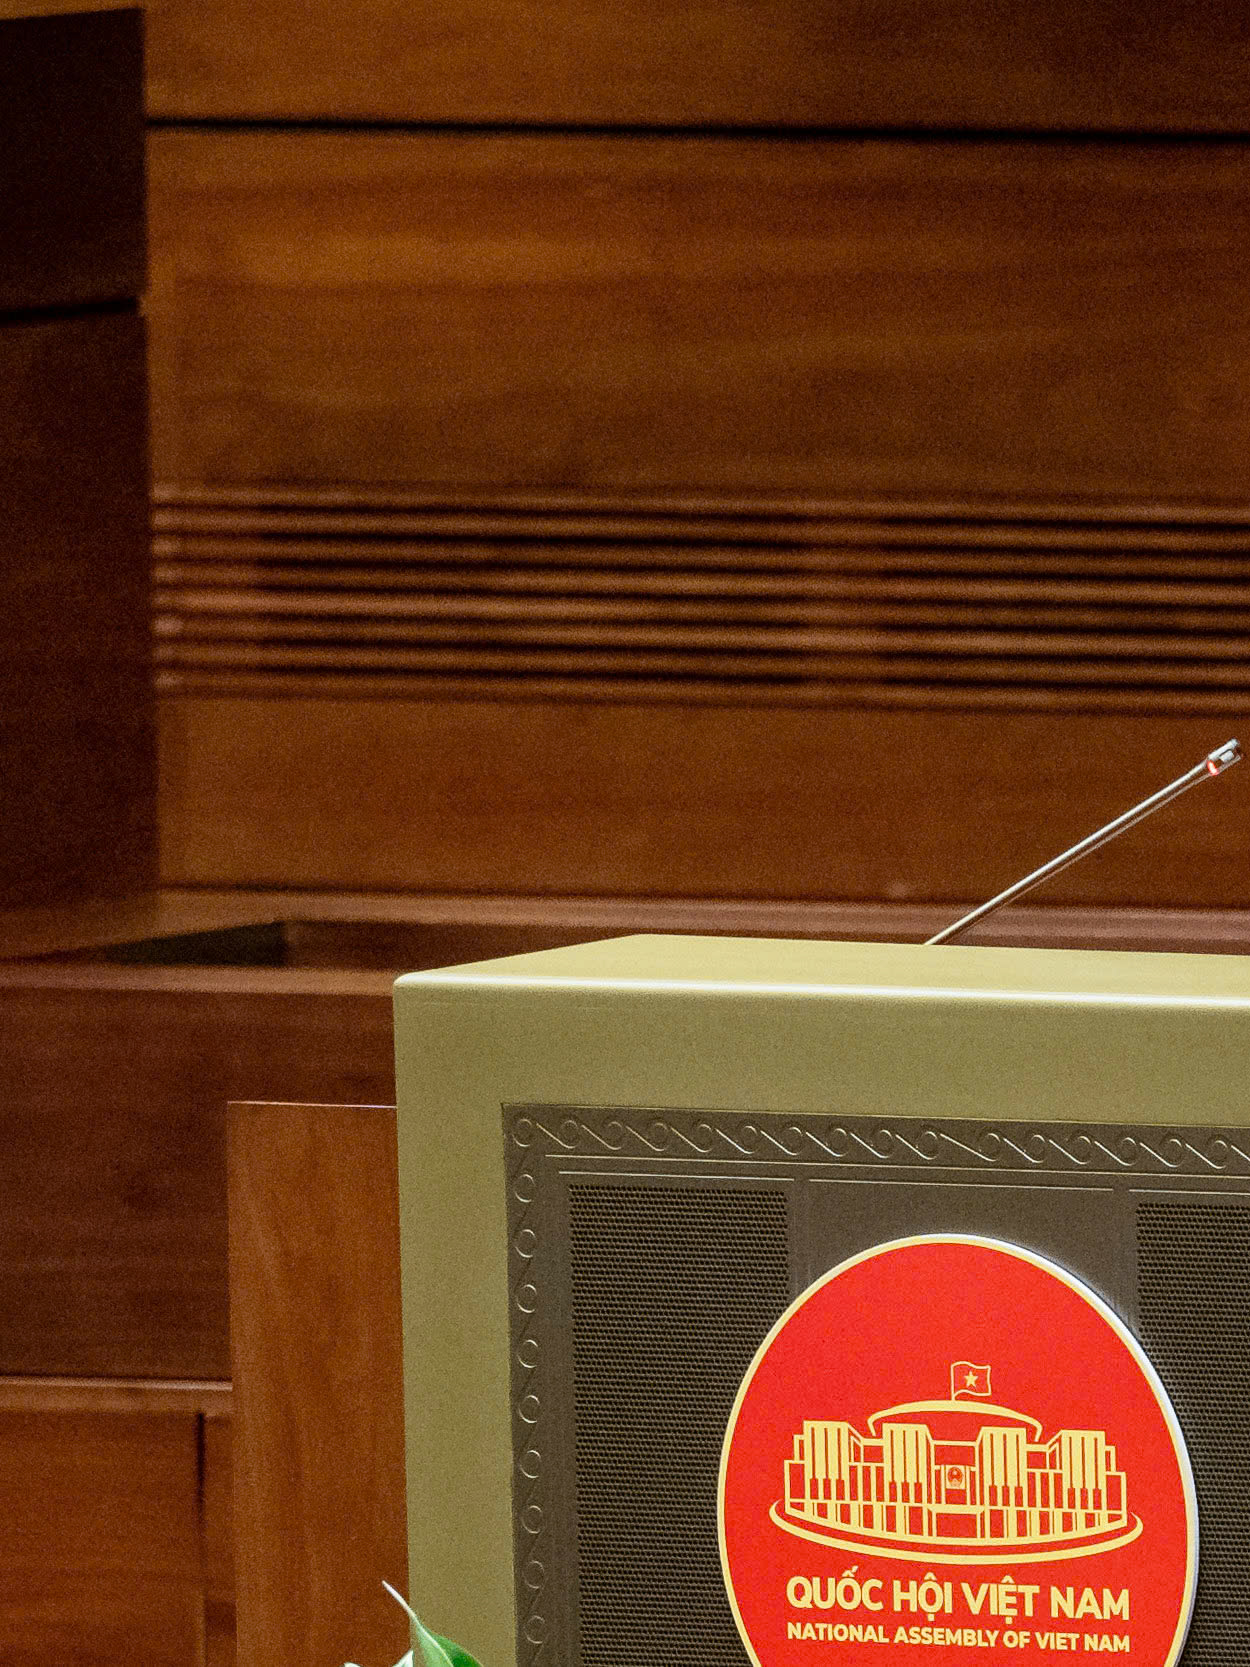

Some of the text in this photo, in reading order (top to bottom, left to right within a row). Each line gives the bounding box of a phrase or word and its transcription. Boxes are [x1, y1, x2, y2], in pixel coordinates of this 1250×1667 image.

[786, 1565, 1130, 1624] QUỐC HỘI VIỆT NAM
[787, 1622, 1131, 1653] NATIONAL ASSEMBLY OF VIET NAM
